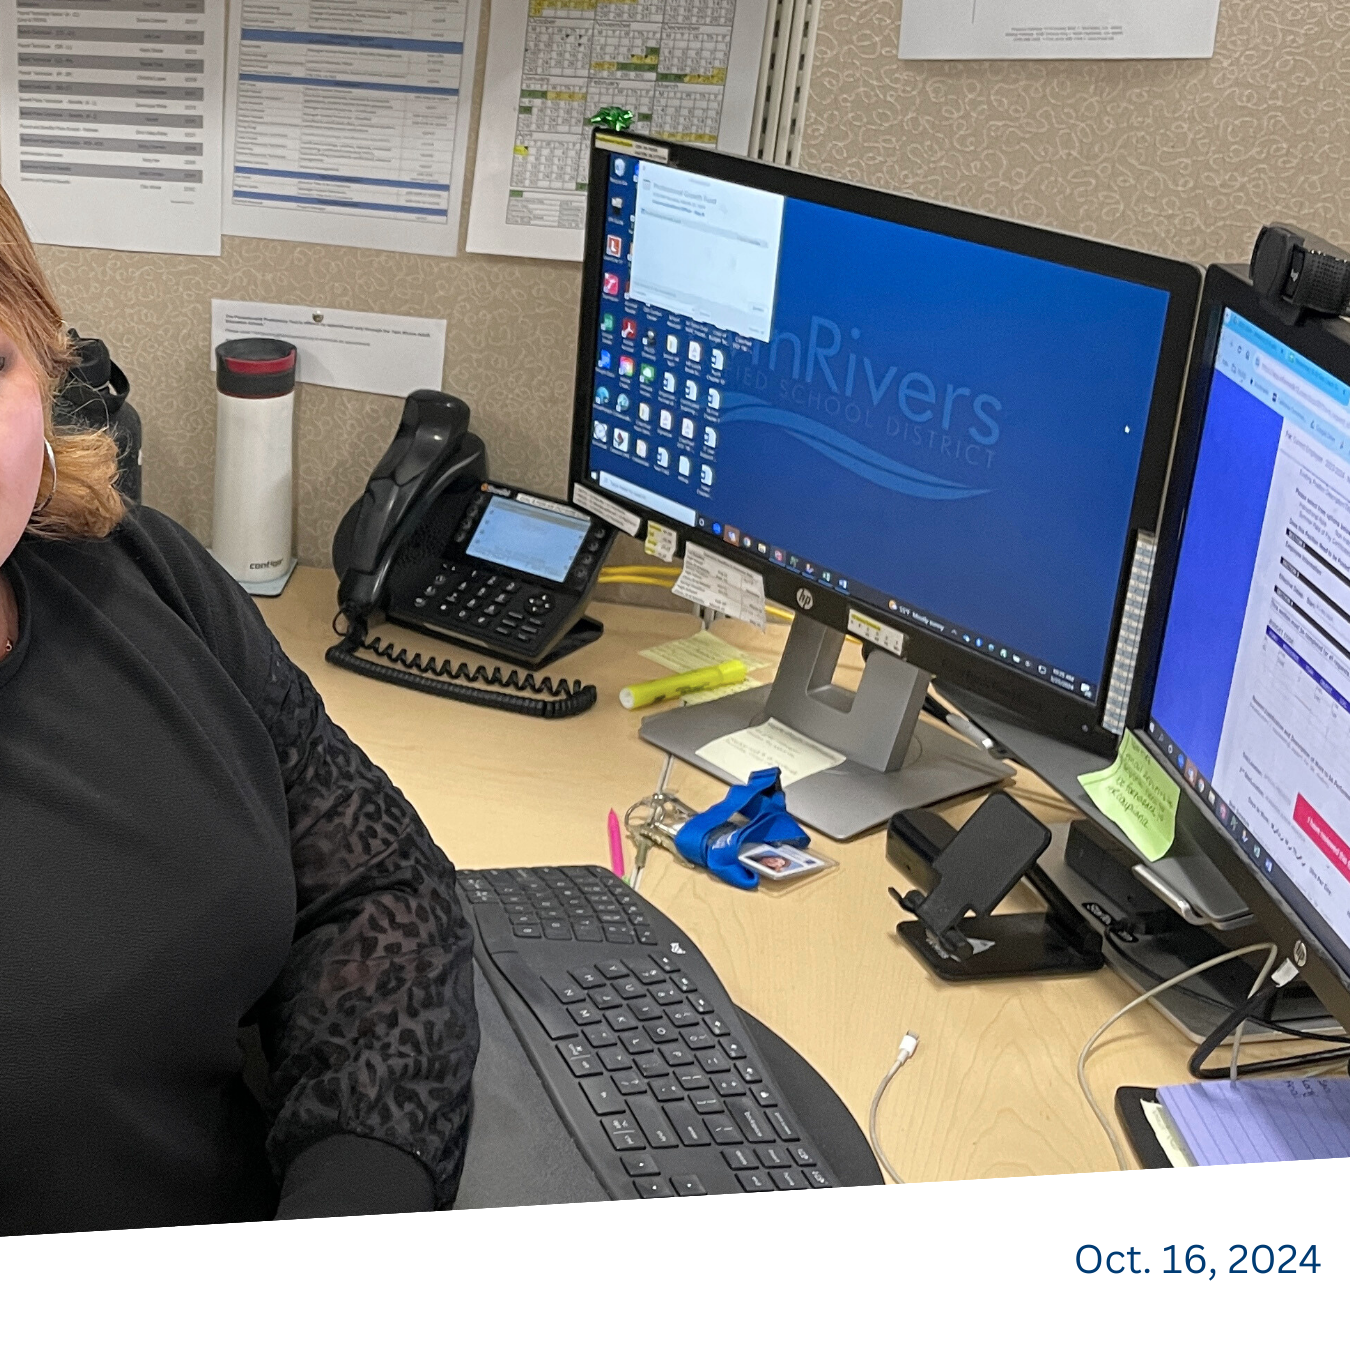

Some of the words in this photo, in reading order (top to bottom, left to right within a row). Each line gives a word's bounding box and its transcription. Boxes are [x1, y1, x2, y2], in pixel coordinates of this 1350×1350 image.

[779, 378, 872, 428] SCHOOL
[886, 416, 998, 469] DISTRICT
[797, 587, 814, 609] hp
